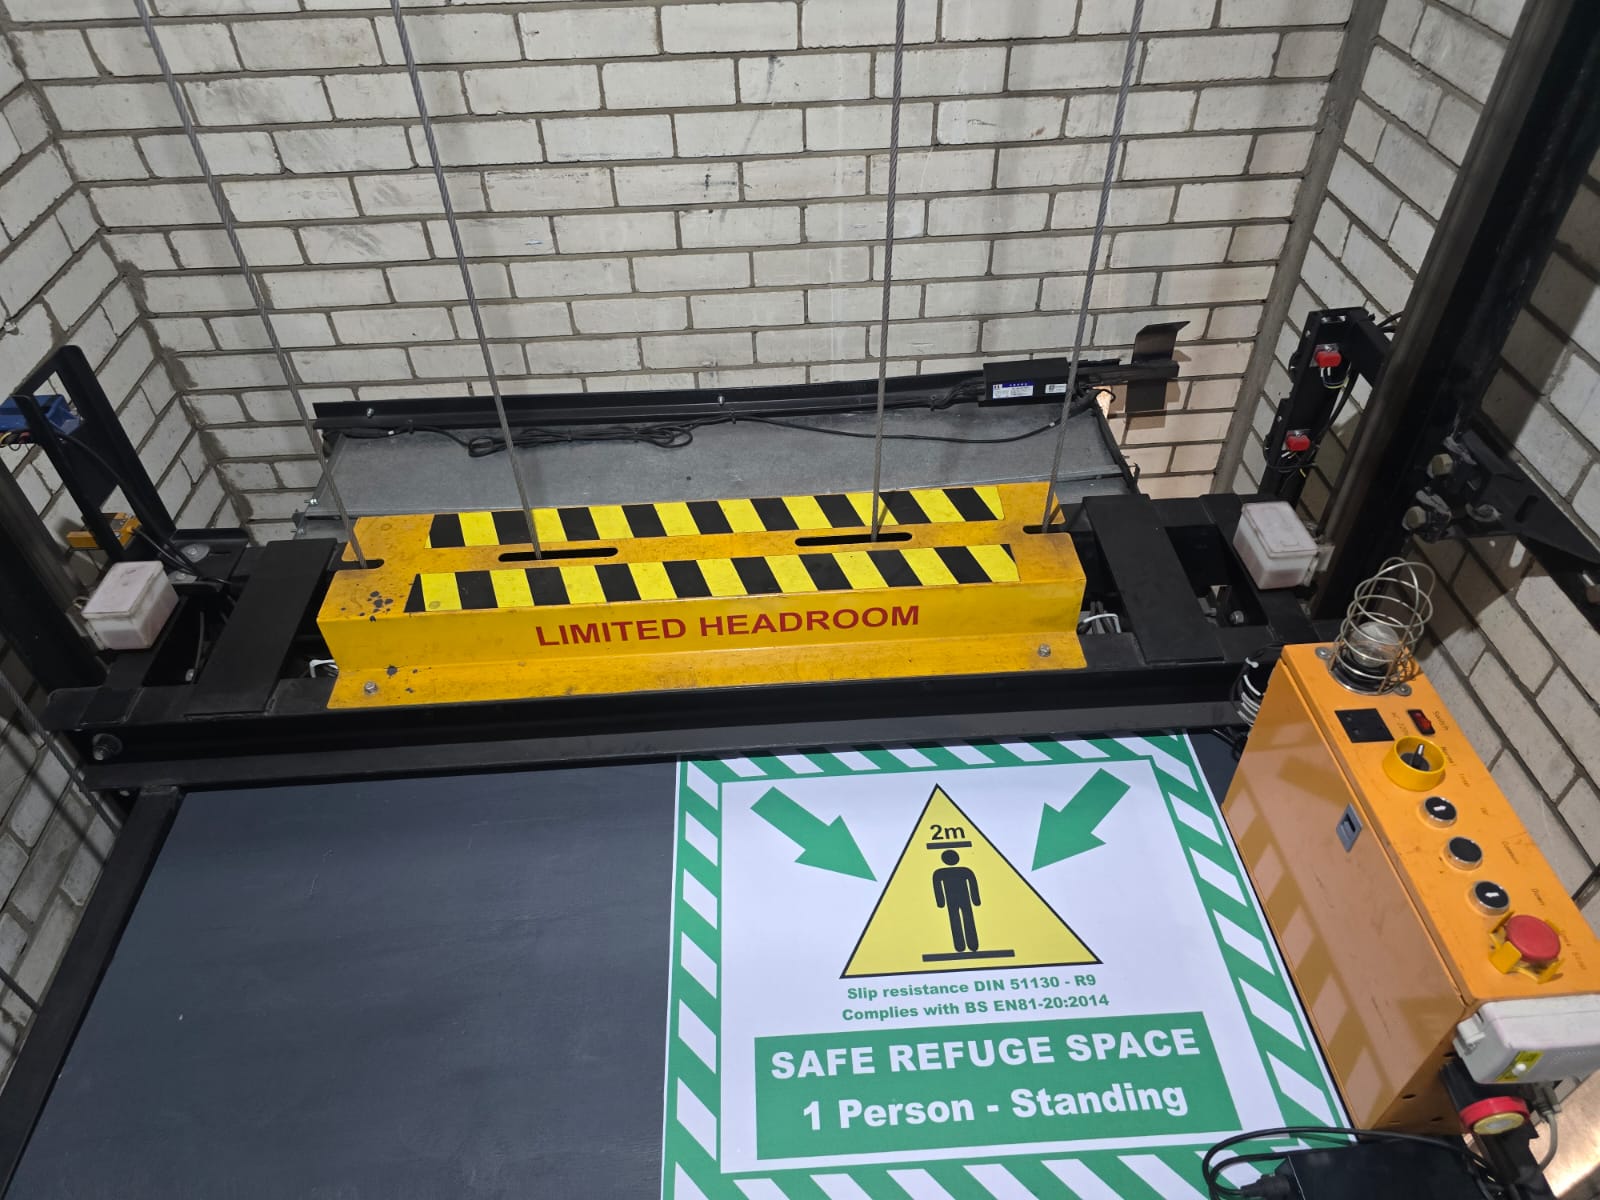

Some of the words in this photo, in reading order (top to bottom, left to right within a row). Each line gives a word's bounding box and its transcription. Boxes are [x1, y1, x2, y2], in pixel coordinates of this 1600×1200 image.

[535, 618, 686, 647] LIMITED
[699, 605, 919, 637] HEADROOM
[930, 824, 966, 841] 2m
[847, 986, 879, 1002] Slip
[882, 983, 970, 998] resistance
[973, 978, 1006, 993] DIN
[1009, 975, 1061, 991] 51130
[1073, 973, 1097, 987] R9
[841, 1005, 920, 1022] Complies
[922, 1002, 960, 1017] with
[964, 1000, 989, 1014] BS
[992, 993, 1110, 1013] EN81-20:2014
[771, 1046, 876, 1080] SAFE
[888, 1036, 1055, 1073] REFUGE
[1066, 1028, 1201, 1062] SPACE
[803, 1100, 821, 1131] 1
[838, 1099, 975, 1129] Person
[1010, 1082, 1188, 1118] Standing
